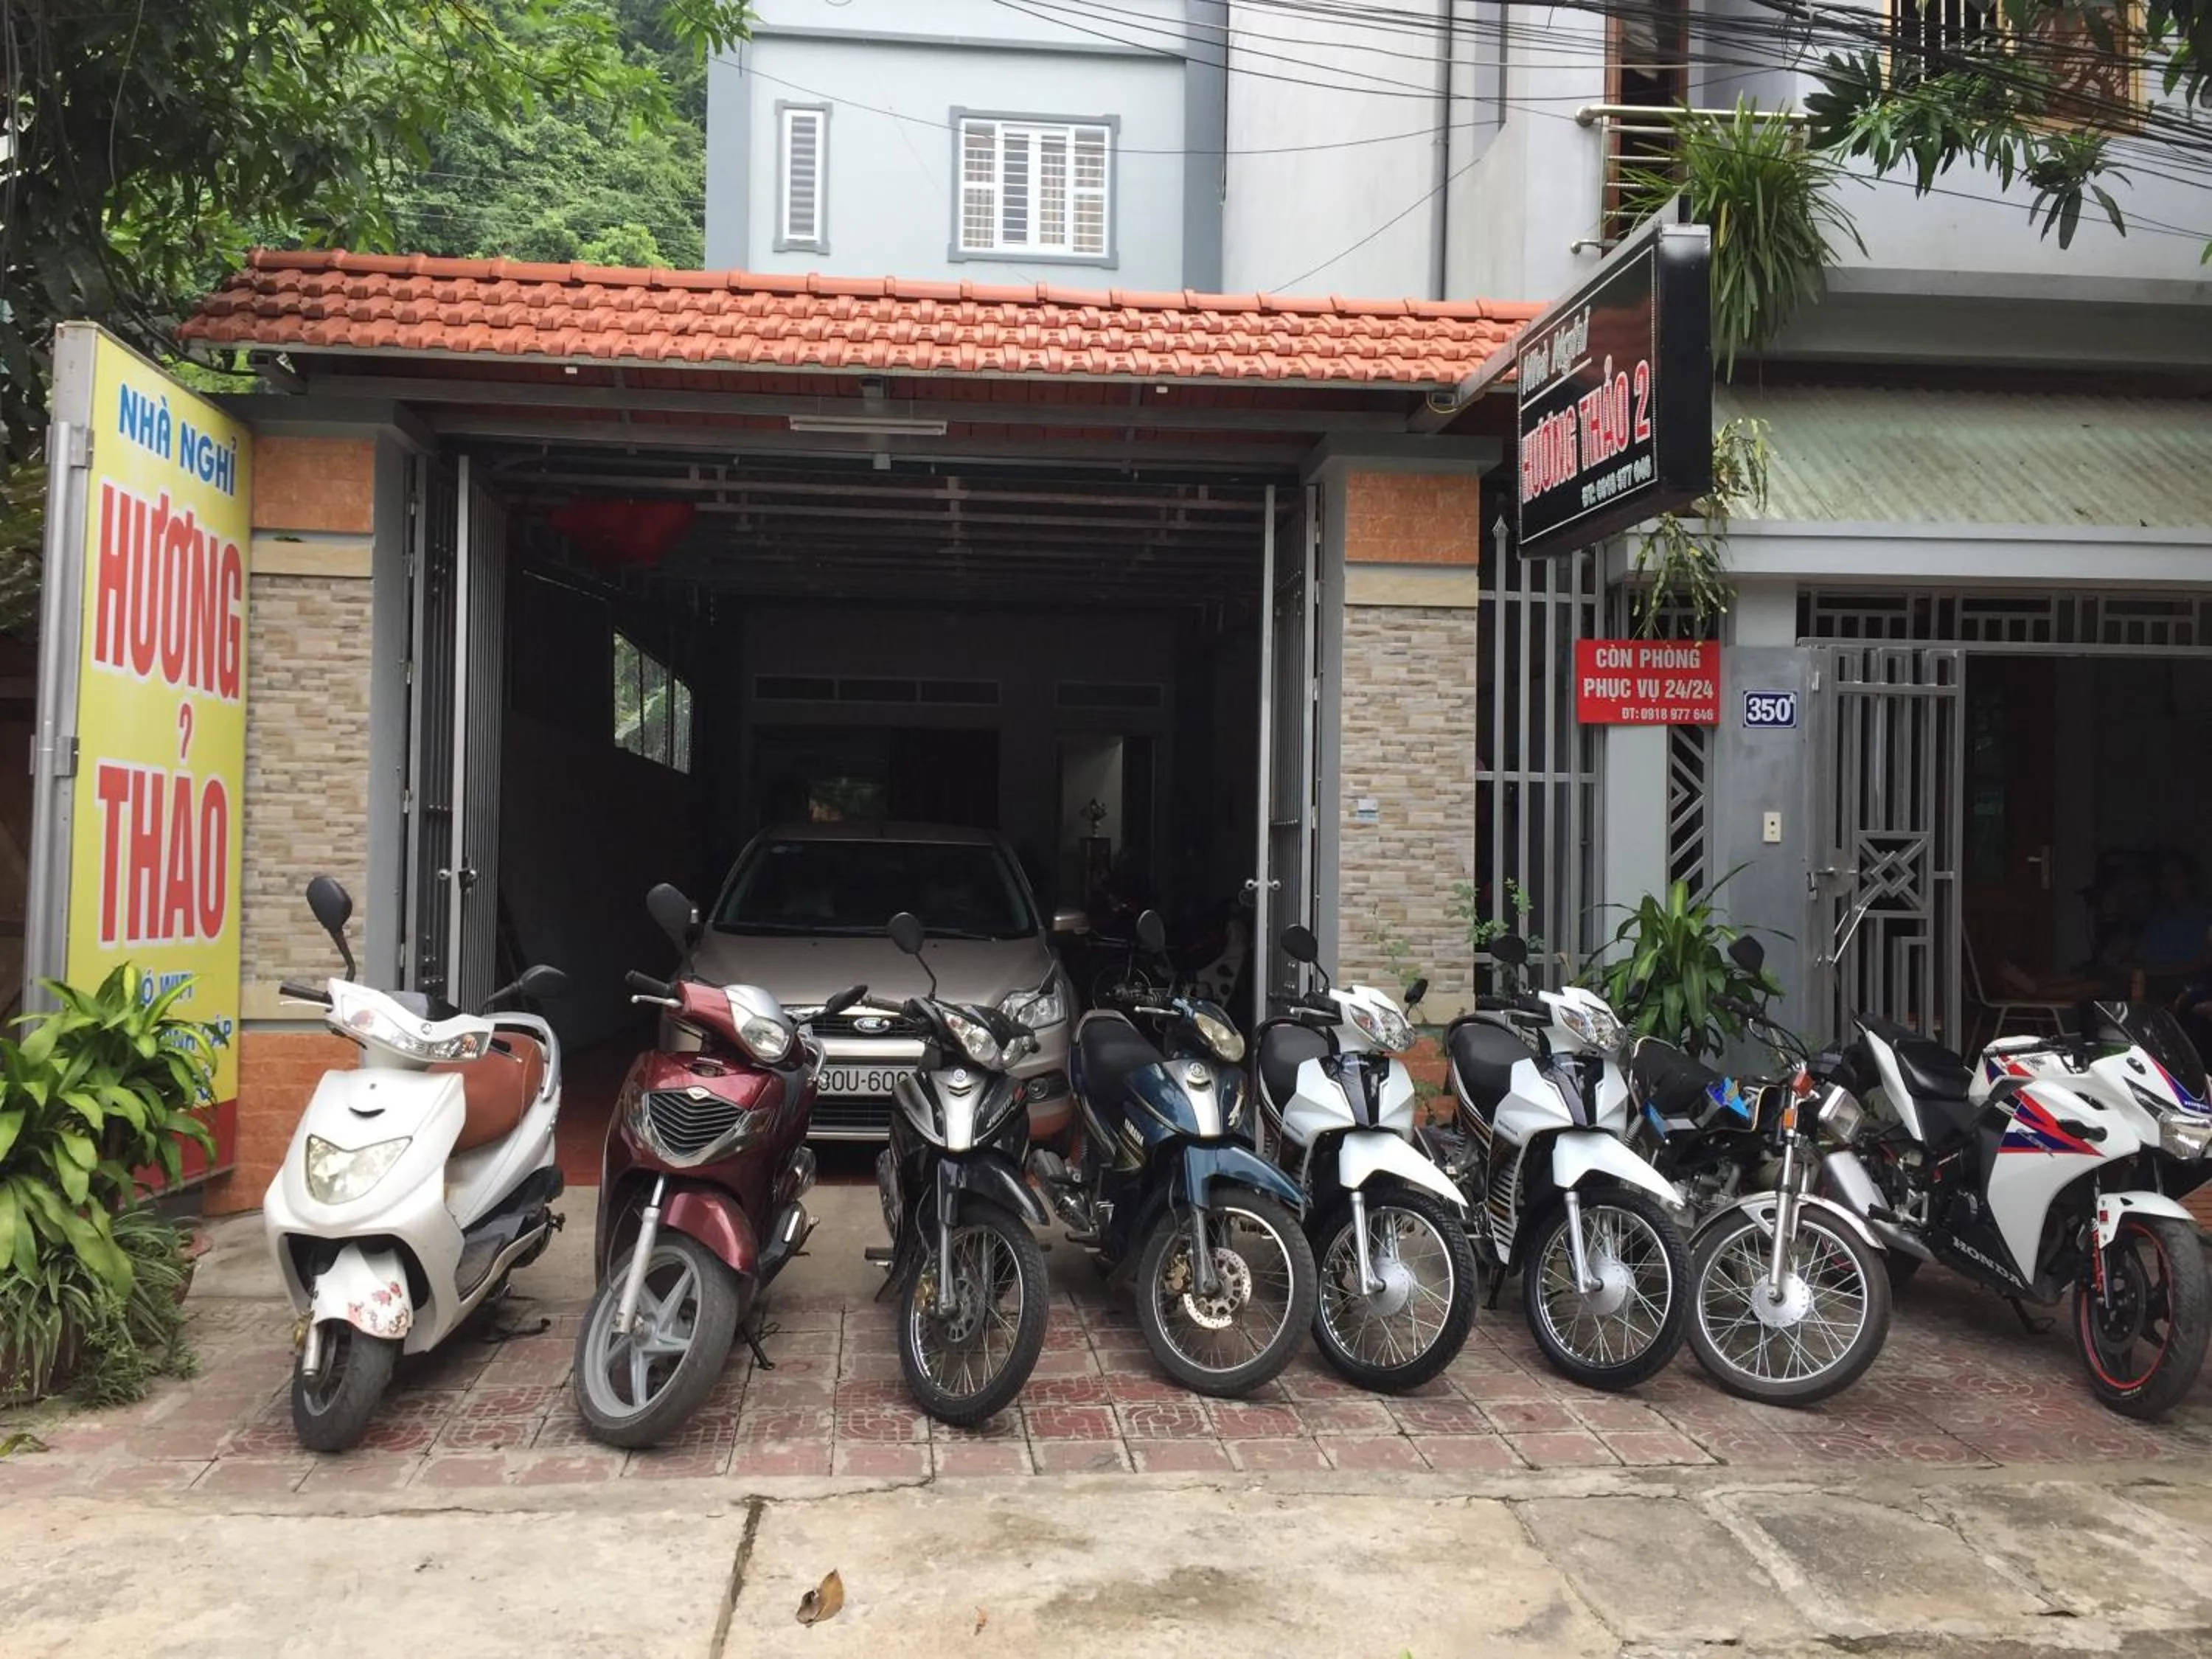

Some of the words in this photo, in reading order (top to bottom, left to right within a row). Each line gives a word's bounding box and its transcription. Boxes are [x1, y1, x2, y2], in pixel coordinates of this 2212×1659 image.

[118, 383, 172, 460] NHÀ
[179, 421, 238, 496] NGHỈ
[1578, 354, 1630, 472] THẢO
[1634, 359, 1651, 445] 2
[94, 483, 242, 699] HƯƠNG
[1583, 678, 1632, 703] PHỤC
[1637, 678, 1659, 703] VỤ
[1664, 678, 1714, 699] 24/24
[1596, 644, 1632, 669] CÒN
[1639, 644, 1701, 669] PHÒNG
[1670, 708, 1690, 720] 977
[98, 703, 228, 942] THẢO
[1952, 1236, 2025, 1290] HONDA
